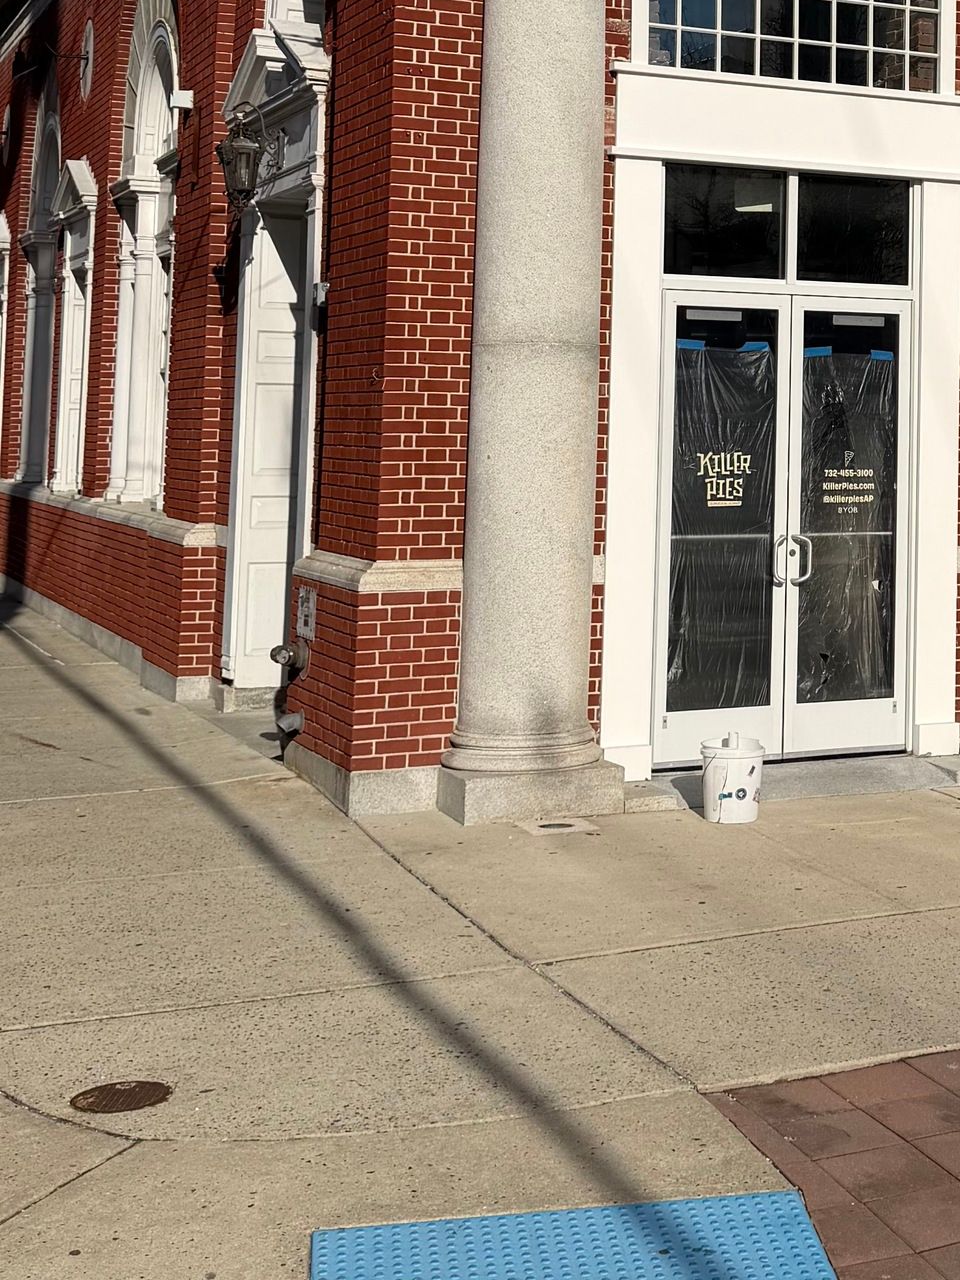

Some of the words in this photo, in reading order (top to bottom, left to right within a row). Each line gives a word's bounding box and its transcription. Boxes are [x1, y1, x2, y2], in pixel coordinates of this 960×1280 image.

[696, 451, 752, 477] KILLER
[823, 469, 874, 477] 732-455-3100
[704, 477, 743, 500] PIES
[822, 482, 875, 490] KillerPies.com
